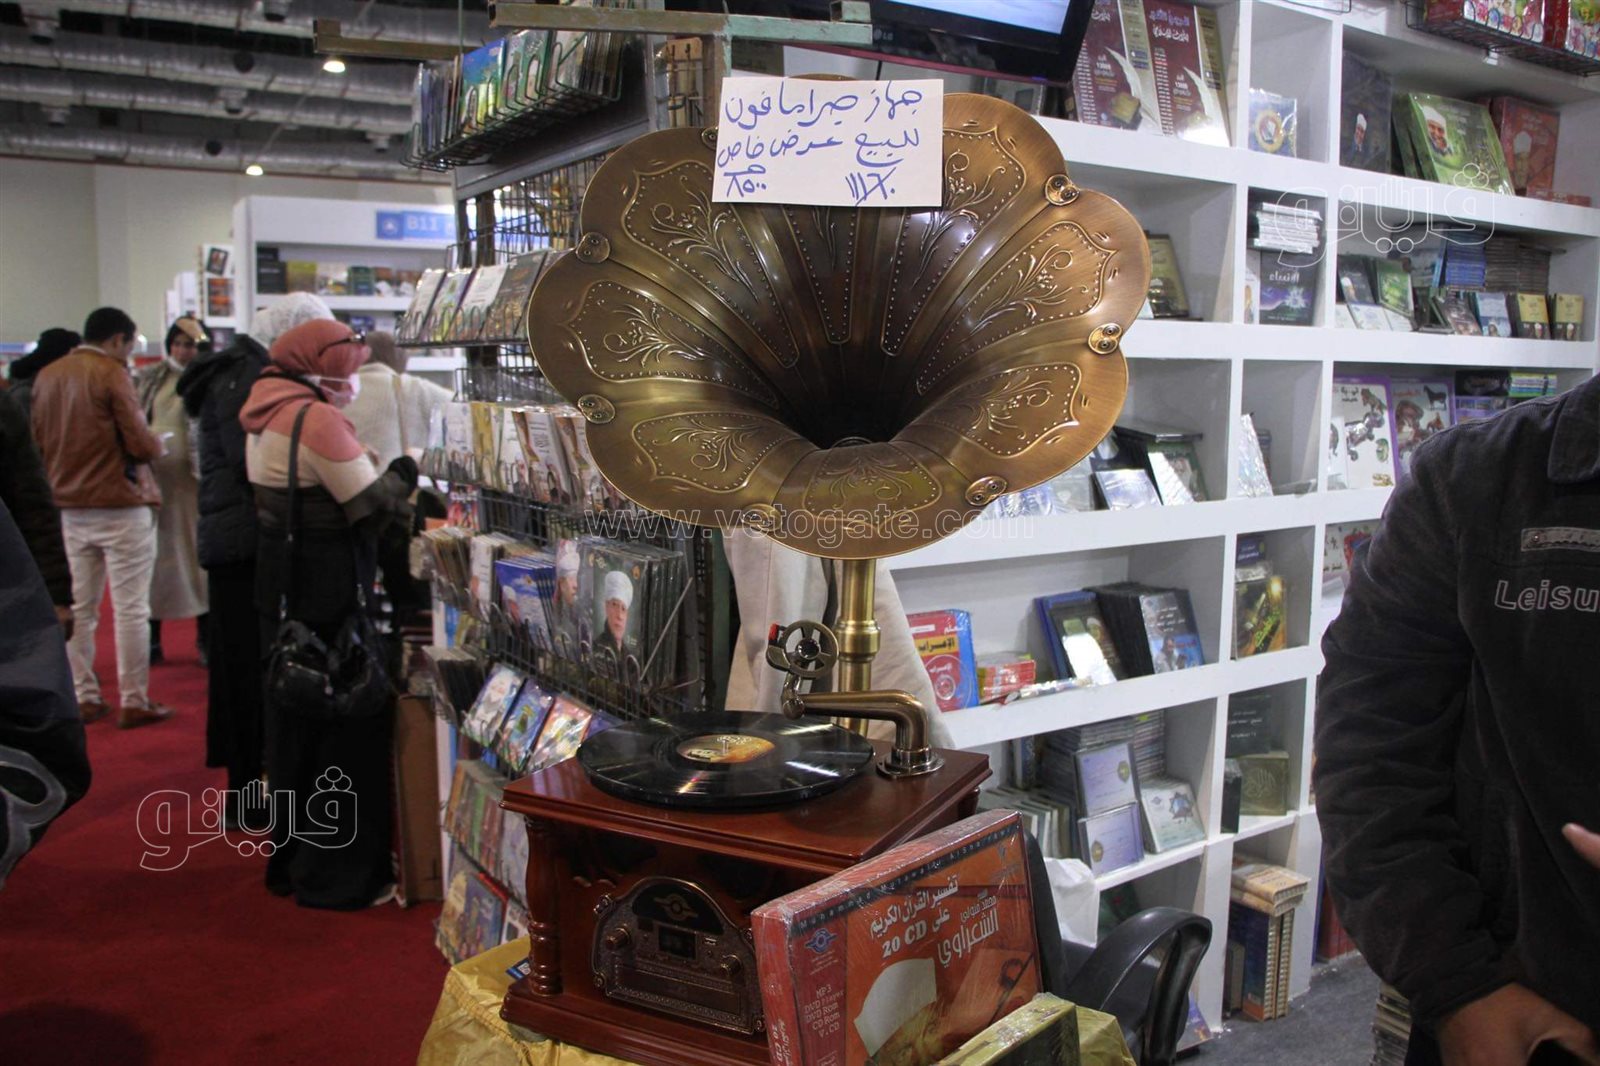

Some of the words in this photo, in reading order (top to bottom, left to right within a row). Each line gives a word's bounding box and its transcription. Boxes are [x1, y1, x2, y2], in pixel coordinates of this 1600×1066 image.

[864, 80, 923, 123] جهاز
[717, 135, 765, 168] خاص
[769, 129, 843, 157] عرض
[854, 128, 920, 168] للبيع
[901, 889, 931, 923] القرآن
[930, 874, 960, 909] تفسير
[869, 904, 902, 939] الكريم
[881, 935, 901, 959] 20
[904, 920, 928, 945] CD
